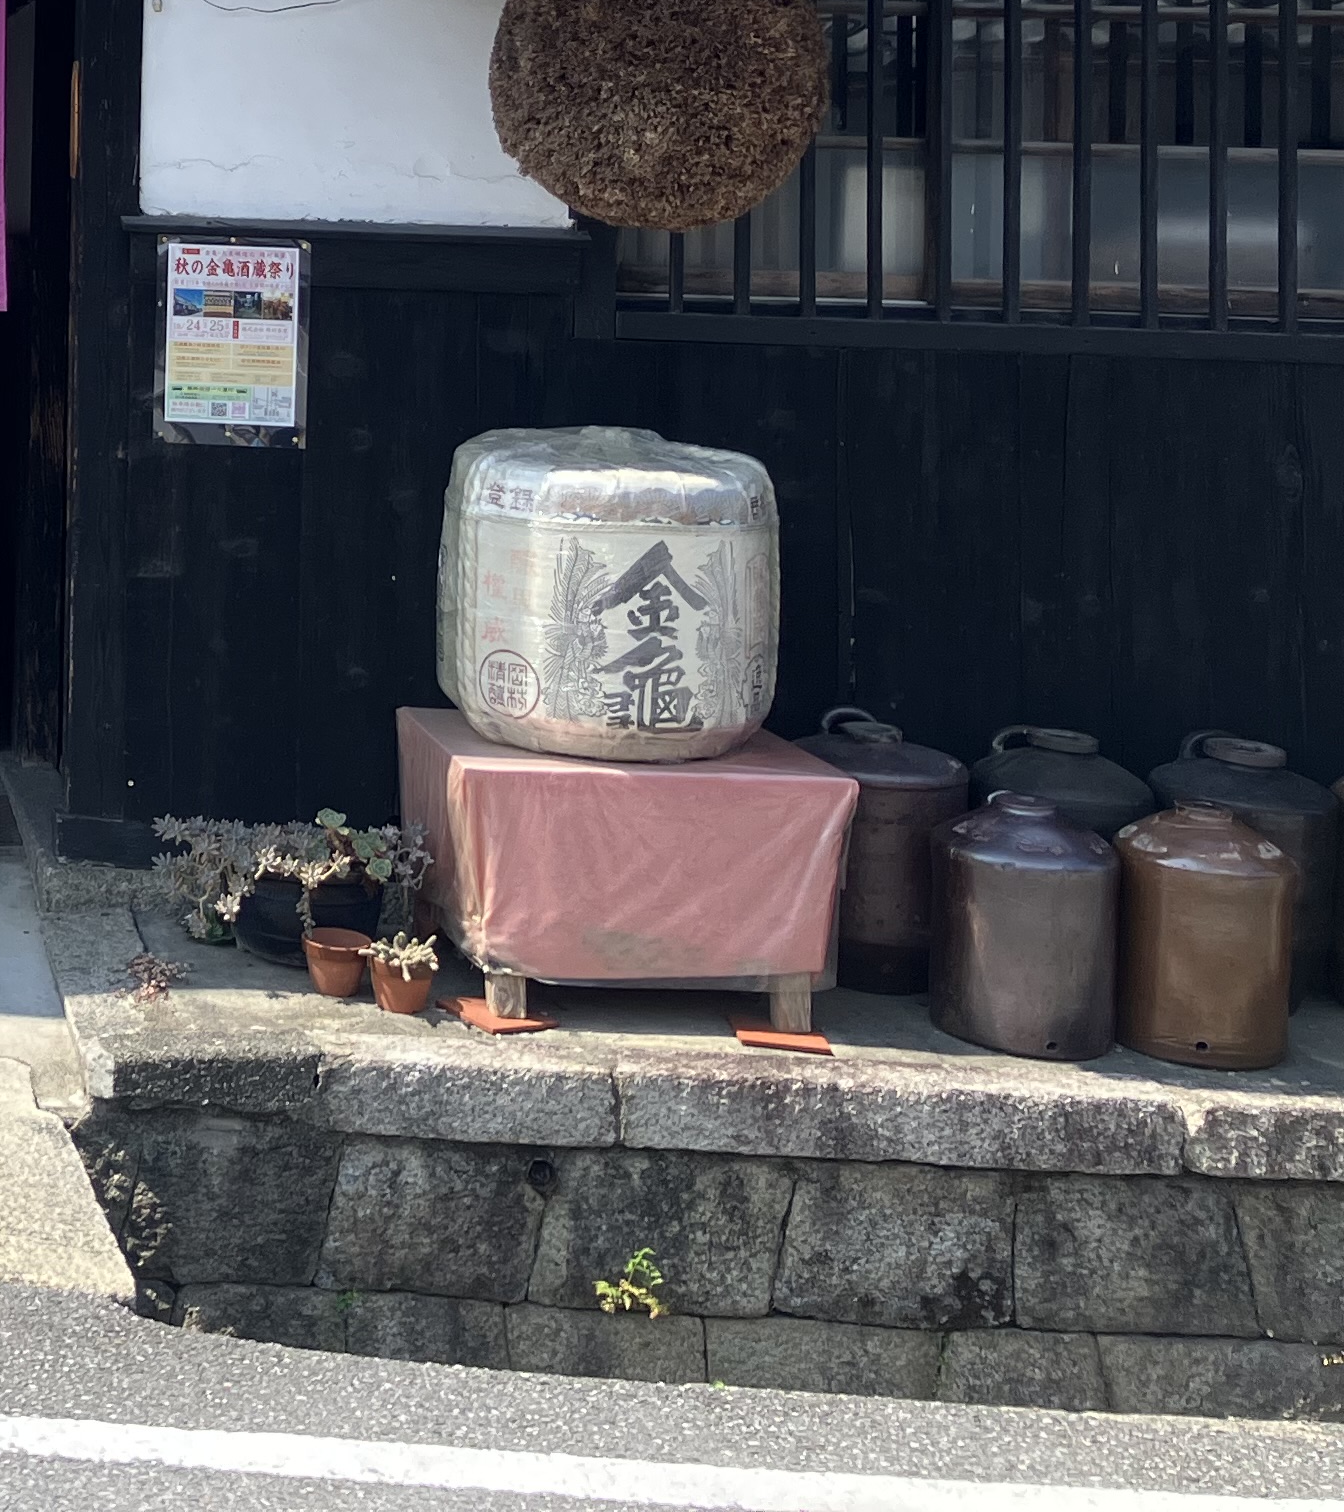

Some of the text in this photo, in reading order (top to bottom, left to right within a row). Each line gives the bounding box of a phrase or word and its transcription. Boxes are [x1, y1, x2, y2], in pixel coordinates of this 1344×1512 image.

[174, 257, 294, 280] 秋の金亀酒蔵祭り
